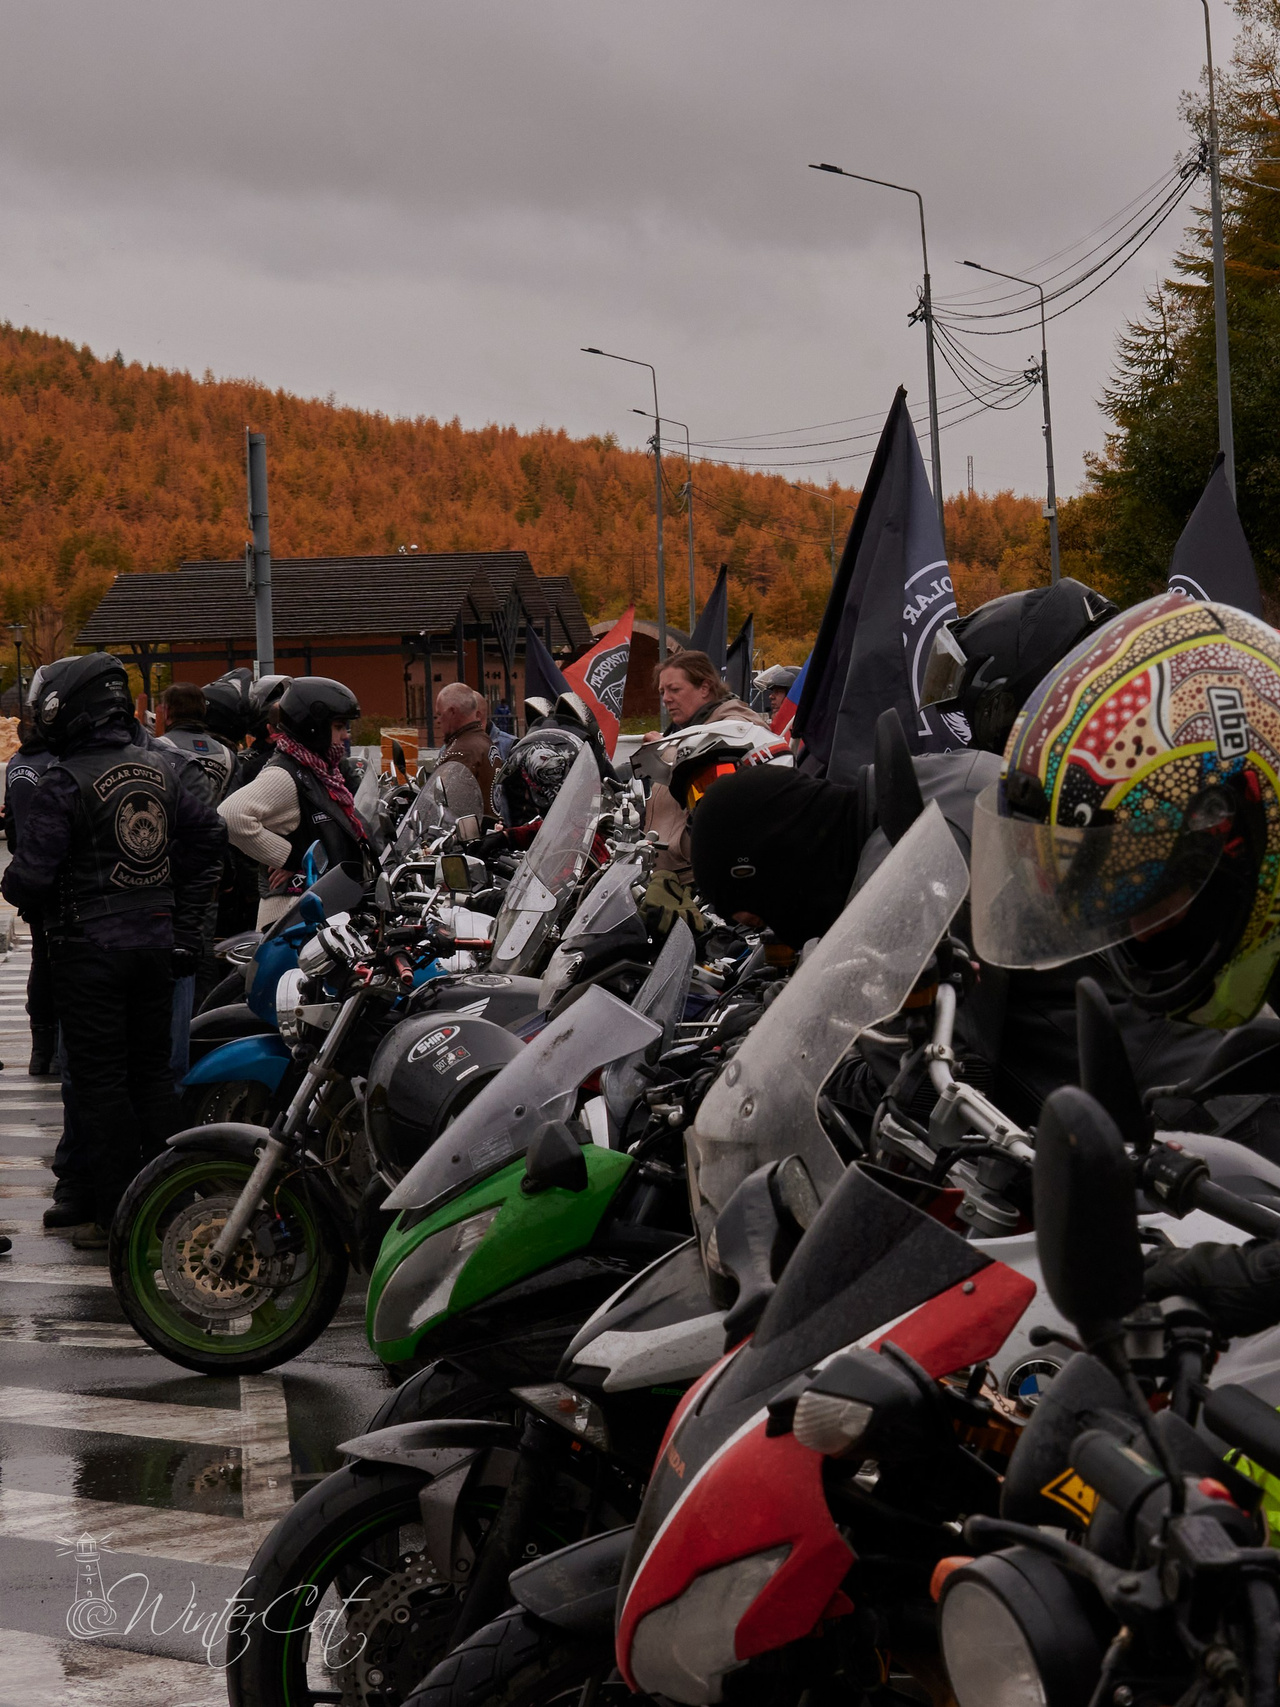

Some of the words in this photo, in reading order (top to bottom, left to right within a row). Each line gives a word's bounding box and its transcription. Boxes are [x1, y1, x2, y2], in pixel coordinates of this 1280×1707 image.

[99, 769, 131, 793] POLAR
[132, 768, 161, 782] OWLS
[117, 865, 168, 885] MAGADAN
[435, 1059, 448, 1071] DOT
